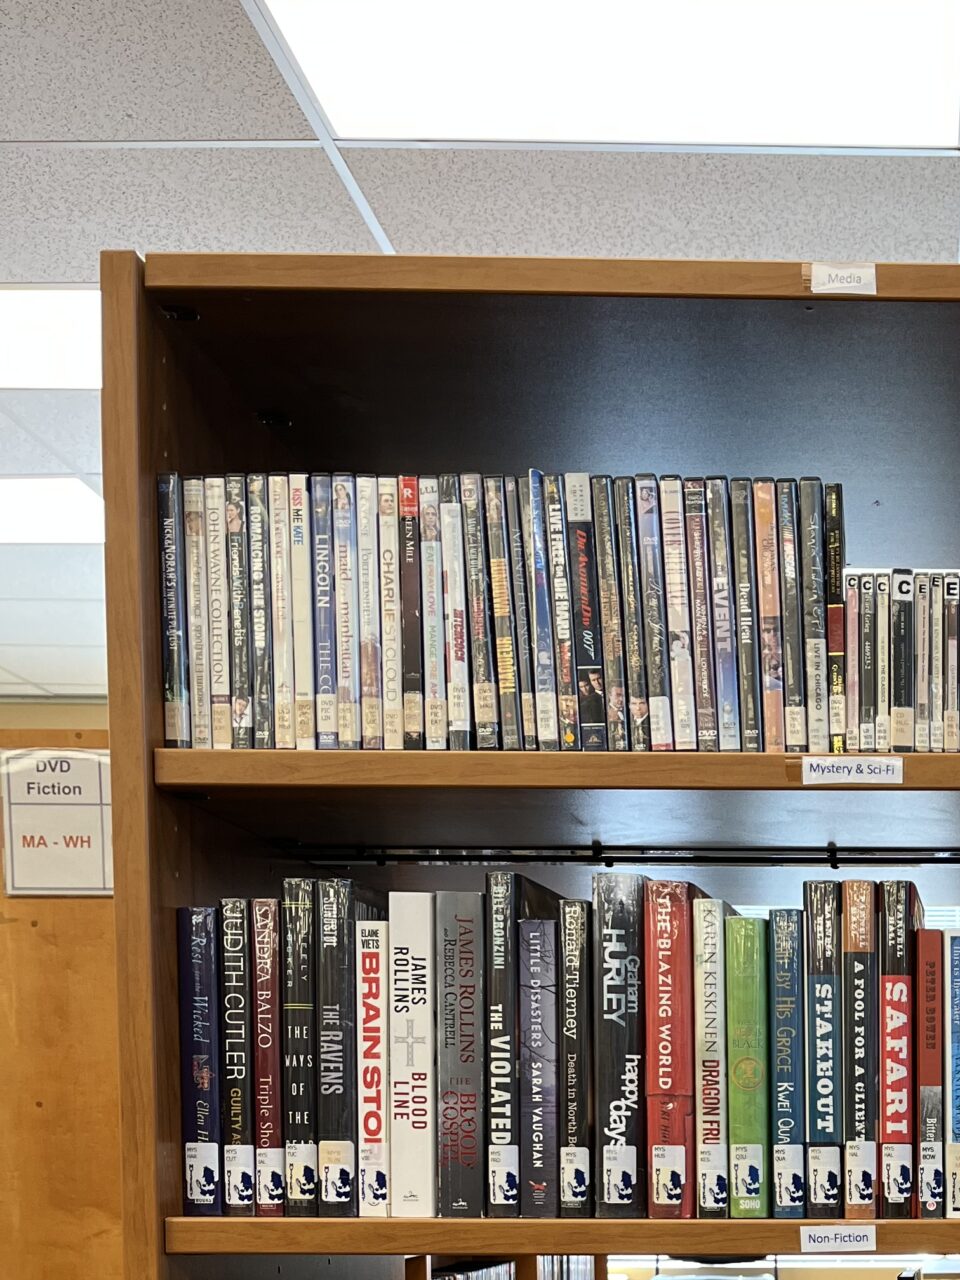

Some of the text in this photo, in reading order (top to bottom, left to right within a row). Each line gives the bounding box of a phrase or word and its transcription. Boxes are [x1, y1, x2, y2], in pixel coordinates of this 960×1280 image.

[828, 274, 862, 284] Media
[292, 488, 303, 545] KISS ME KATE
[316, 535, 330, 608] LINCOLN
[848, 578, 856, 587] C
[898, 581, 910, 594] C
[946, 582, 957, 595] E
[208, 508, 223, 684] JOHN WAYNE COLLECTION
[814, 666, 820, 674] IN
[36, 760, 70, 773] DVD
[810, 764, 894, 775] Mystery & Sci-Fi
[27, 782, 82, 795] Fiction
[22, 835, 48, 848] MA
[63, 835, 90, 848] WH
[361, 929, 379, 938] ELAINE
[361, 938, 379, 950] VIETS
[394, 947, 409, 1014] ROLLINS
[411, 956, 427, 1006] JAMES
[223, 907, 246, 1081] JUDITH CUTLER
[361, 952, 381, 1059] BRAIN
[657, 937, 672, 1089] BLAZING WORLD
[287, 1026, 308, 1039] THE
[321, 1004, 344, 1096] THE RAVENS
[284, 1055, 313, 1068] WAYS
[815, 984, 834, 1133] STAKEOUT
[885, 981, 908, 1135] SAFARI
[490, 1004, 511, 1145] THE VIOLATED
[291, 1083, 305, 1095] OF
[394, 1081, 409, 1120] LINE
[411, 1072, 427, 1130] BLOOD
[289, 1111, 310, 1125] THE
[530, 1062, 543, 1168] SARAH VAUGHAN
[808, 1233, 868, 1244] Non-Fiction
